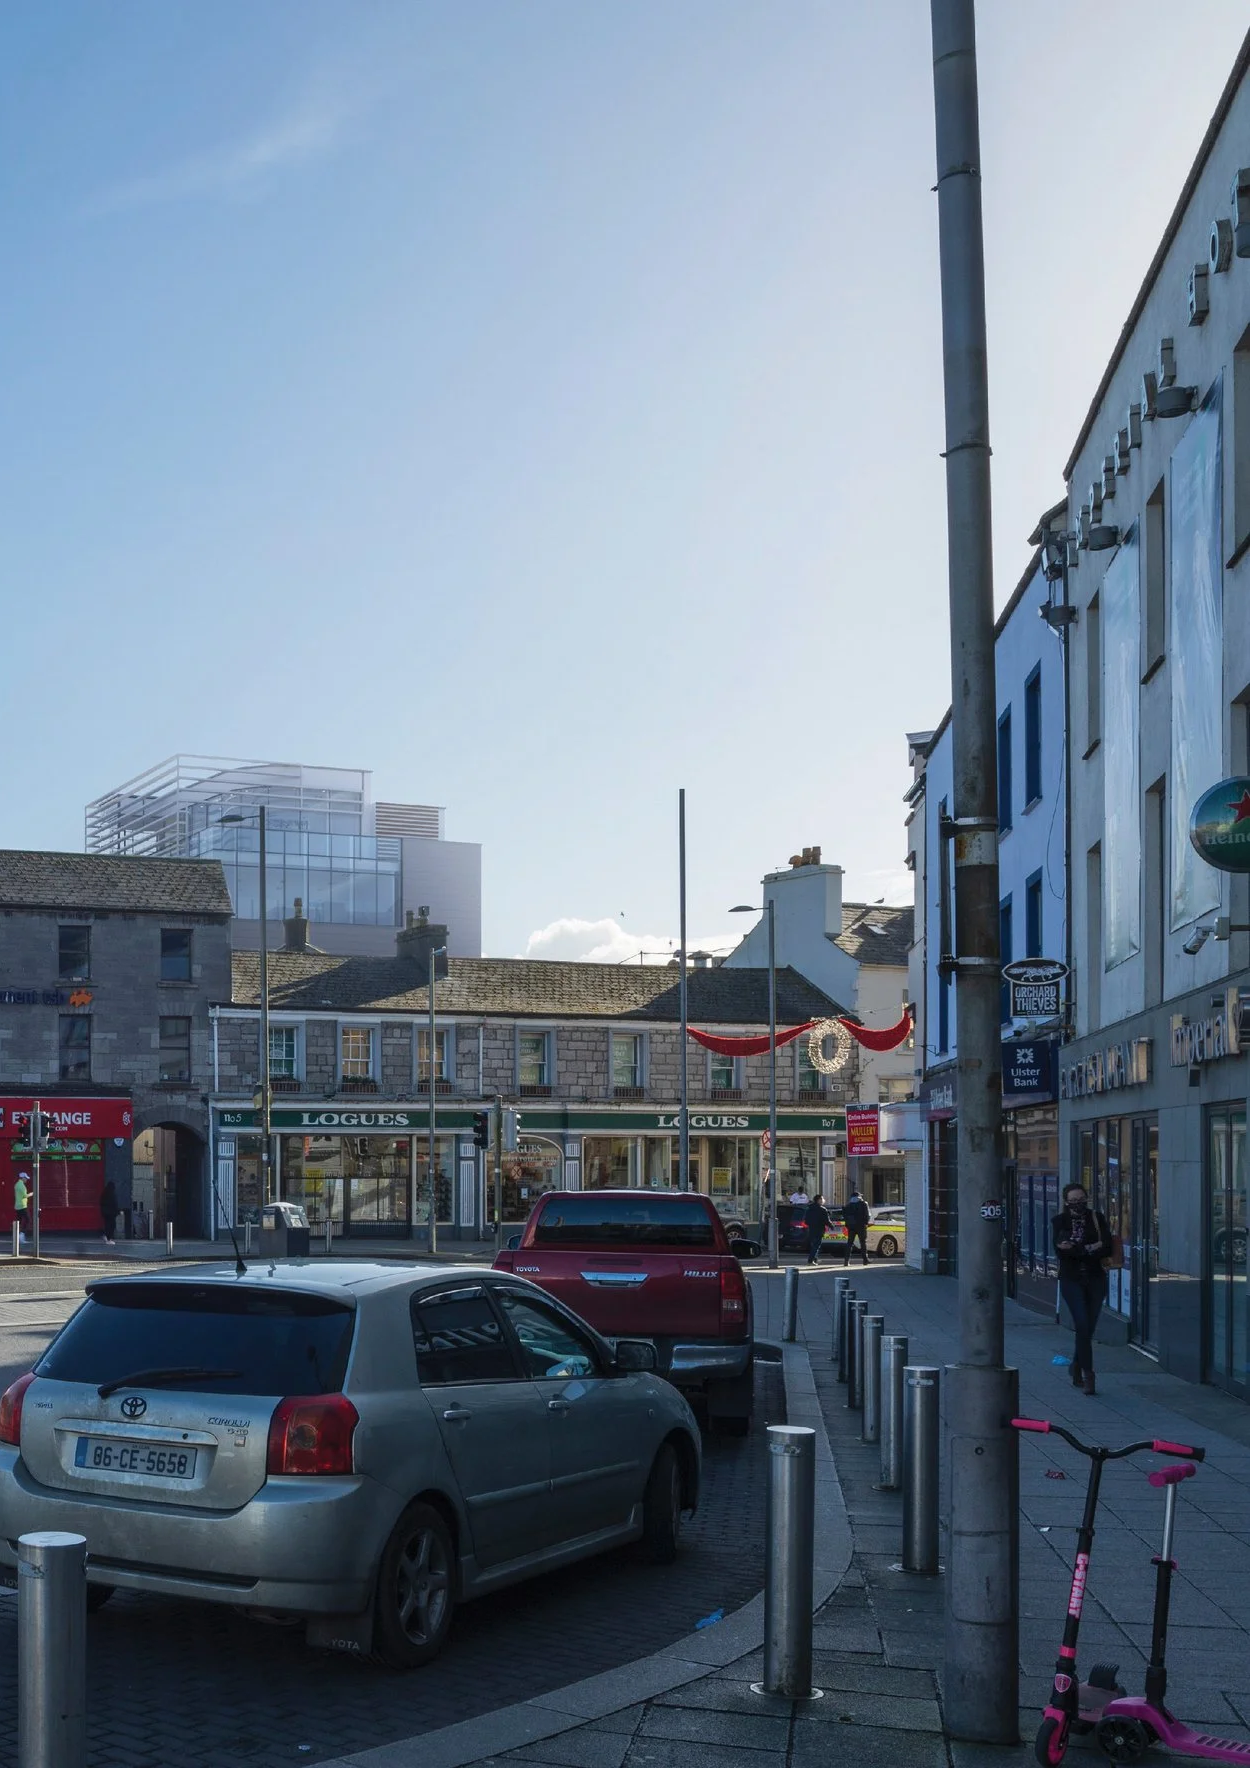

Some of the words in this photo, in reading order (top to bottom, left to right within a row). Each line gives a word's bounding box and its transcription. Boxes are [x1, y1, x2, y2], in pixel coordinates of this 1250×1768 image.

[1204, 831, 1250, 846] Hein
[1015, 987, 1056, 998] ORCHARD
[1016, 998, 1057, 1011] THIEVES
[1011, 1068, 1040, 1077] Ulster
[1014, 1078, 1038, 1087] Bank
[301, 1112, 410, 1125] LOGUES
[850, 1126, 876, 1136] MULLERY
[981, 1205, 1001, 1217] 505
[683, 1270, 718, 1278] HILUX
[207, 1417, 250, 1428] COROLLA
